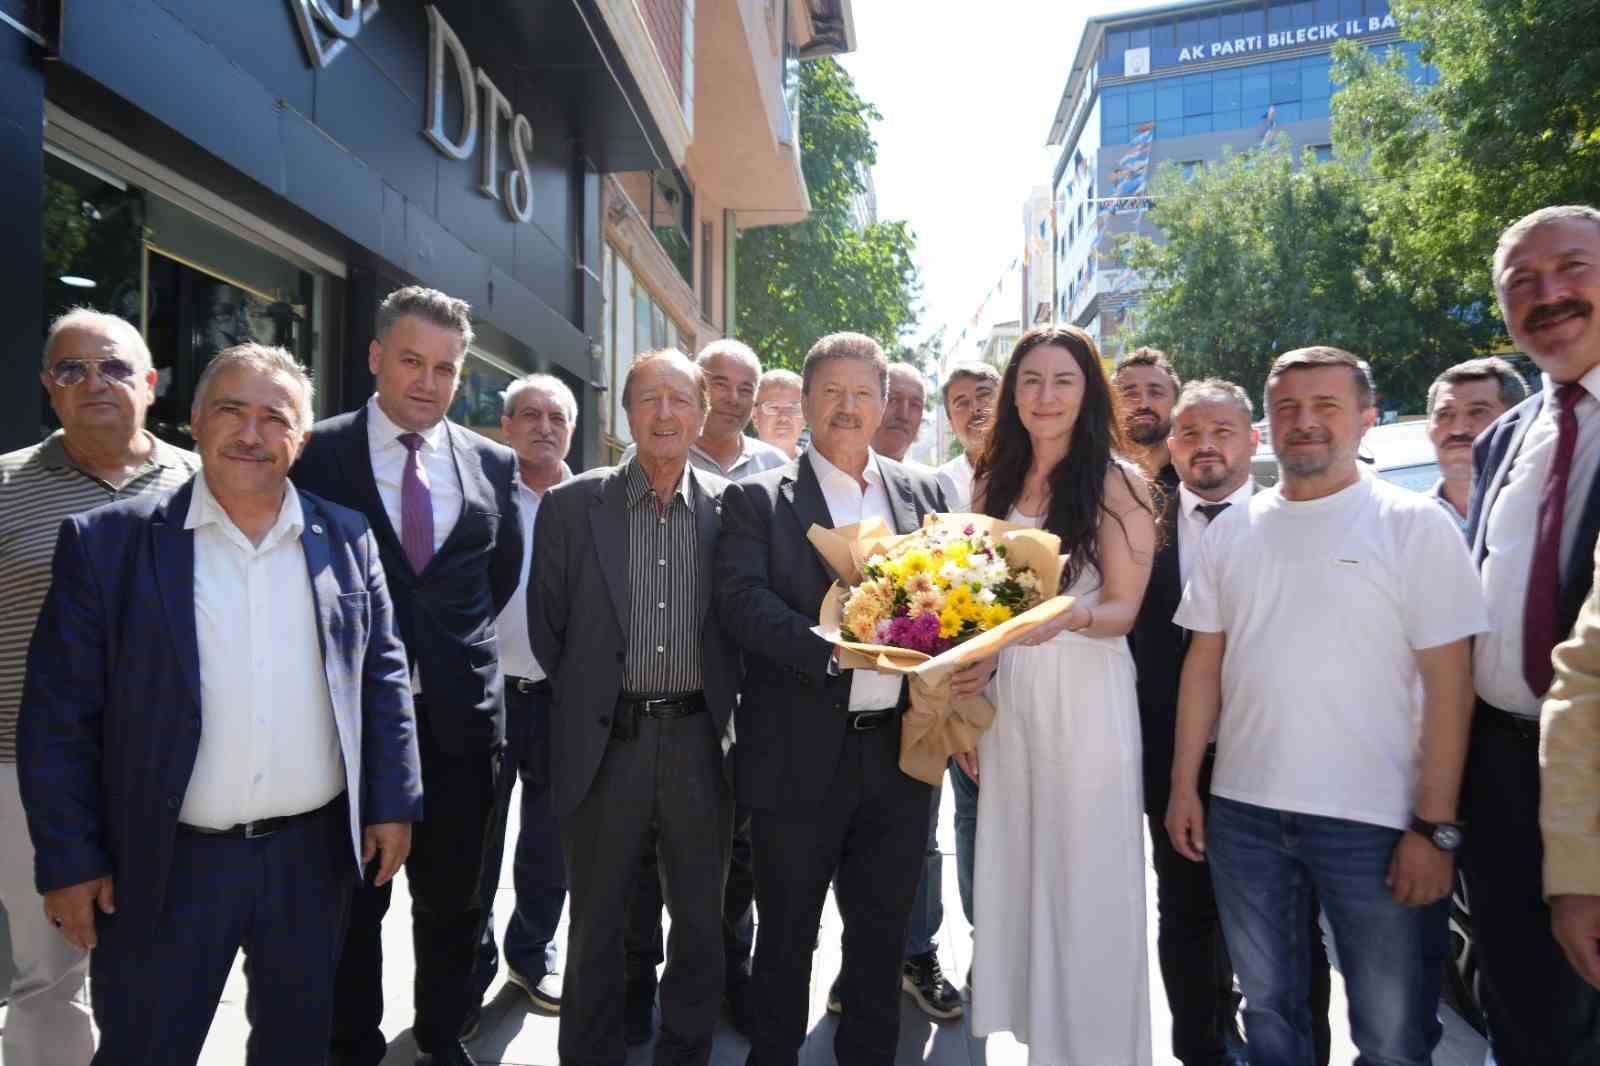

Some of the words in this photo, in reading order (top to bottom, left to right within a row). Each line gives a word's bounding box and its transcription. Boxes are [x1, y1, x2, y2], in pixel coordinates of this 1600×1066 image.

[1178, 44, 1205, 62] AK
[1368, 14, 1396, 31] BA
[424, 3, 533, 223] DTS
